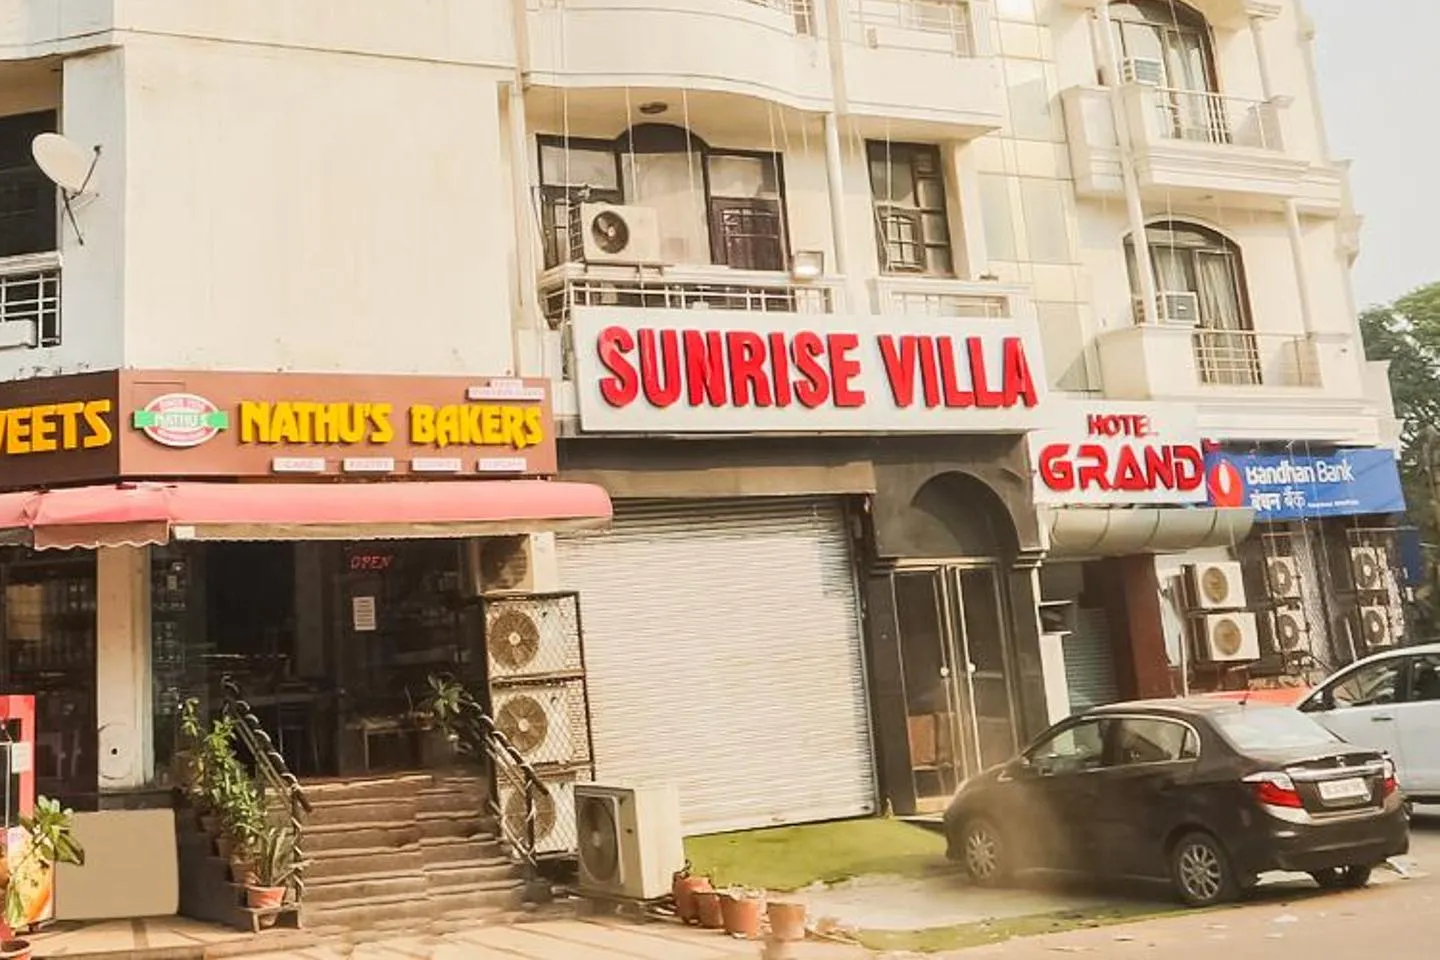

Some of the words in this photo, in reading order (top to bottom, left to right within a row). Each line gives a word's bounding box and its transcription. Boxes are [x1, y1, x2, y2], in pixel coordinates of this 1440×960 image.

[596, 325, 865, 408] SUNRISE
[877, 333, 1039, 408] VILLA
[239, 399, 395, 445] NATHU'S
[409, 403, 545, 450] BAKERS
[1086, 414, 1159, 438] HOTE
[1038, 443, 1205, 492] GRAND
[1316, 459, 1356, 483] Bank
[350, 555, 393, 570] OPEN
